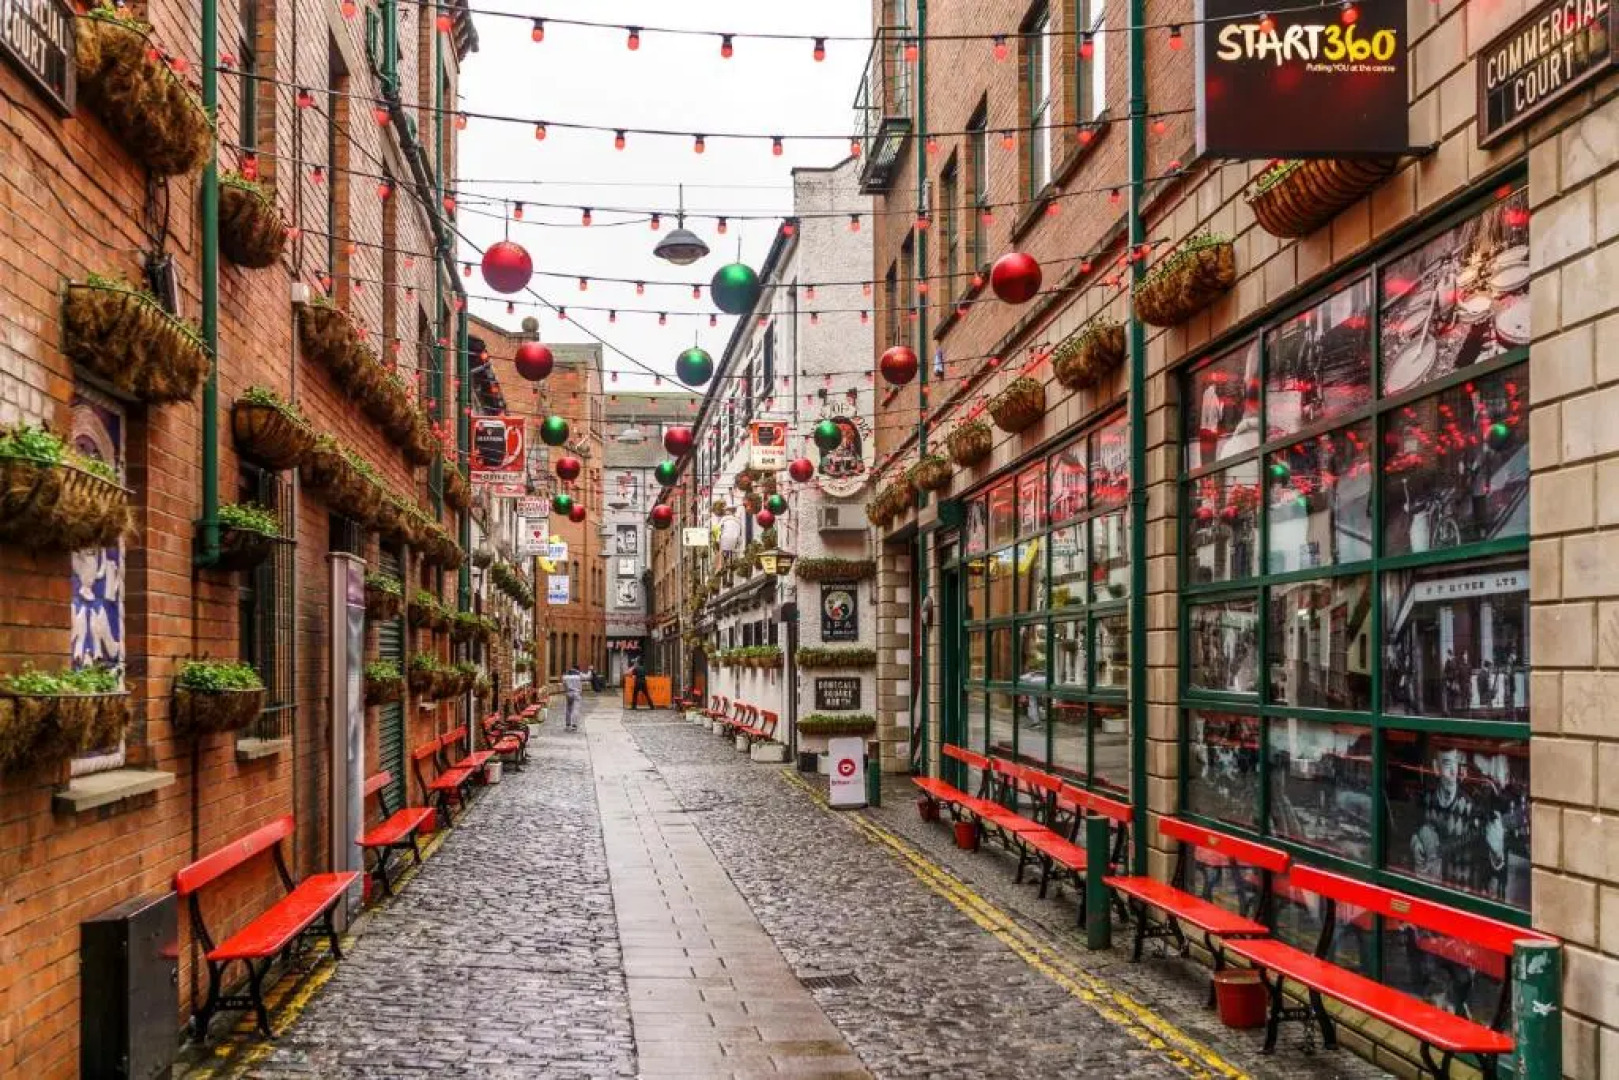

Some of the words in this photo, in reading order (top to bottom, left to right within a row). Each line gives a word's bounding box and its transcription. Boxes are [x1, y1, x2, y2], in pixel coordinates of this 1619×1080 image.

[4, 3, 47, 76] COURT
[17, 0, 68, 56] RCIAL
[1217, 24, 1396, 66] START360
[1487, 0, 1609, 89] COMMERCIAL
[1306, 63, 1332, 73] Putting
[1332, 63, 1350, 72] YOU
[1350, 64, 1358, 72] at
[1359, 63, 1371, 72] the
[1515, 40, 1574, 111] COURT
